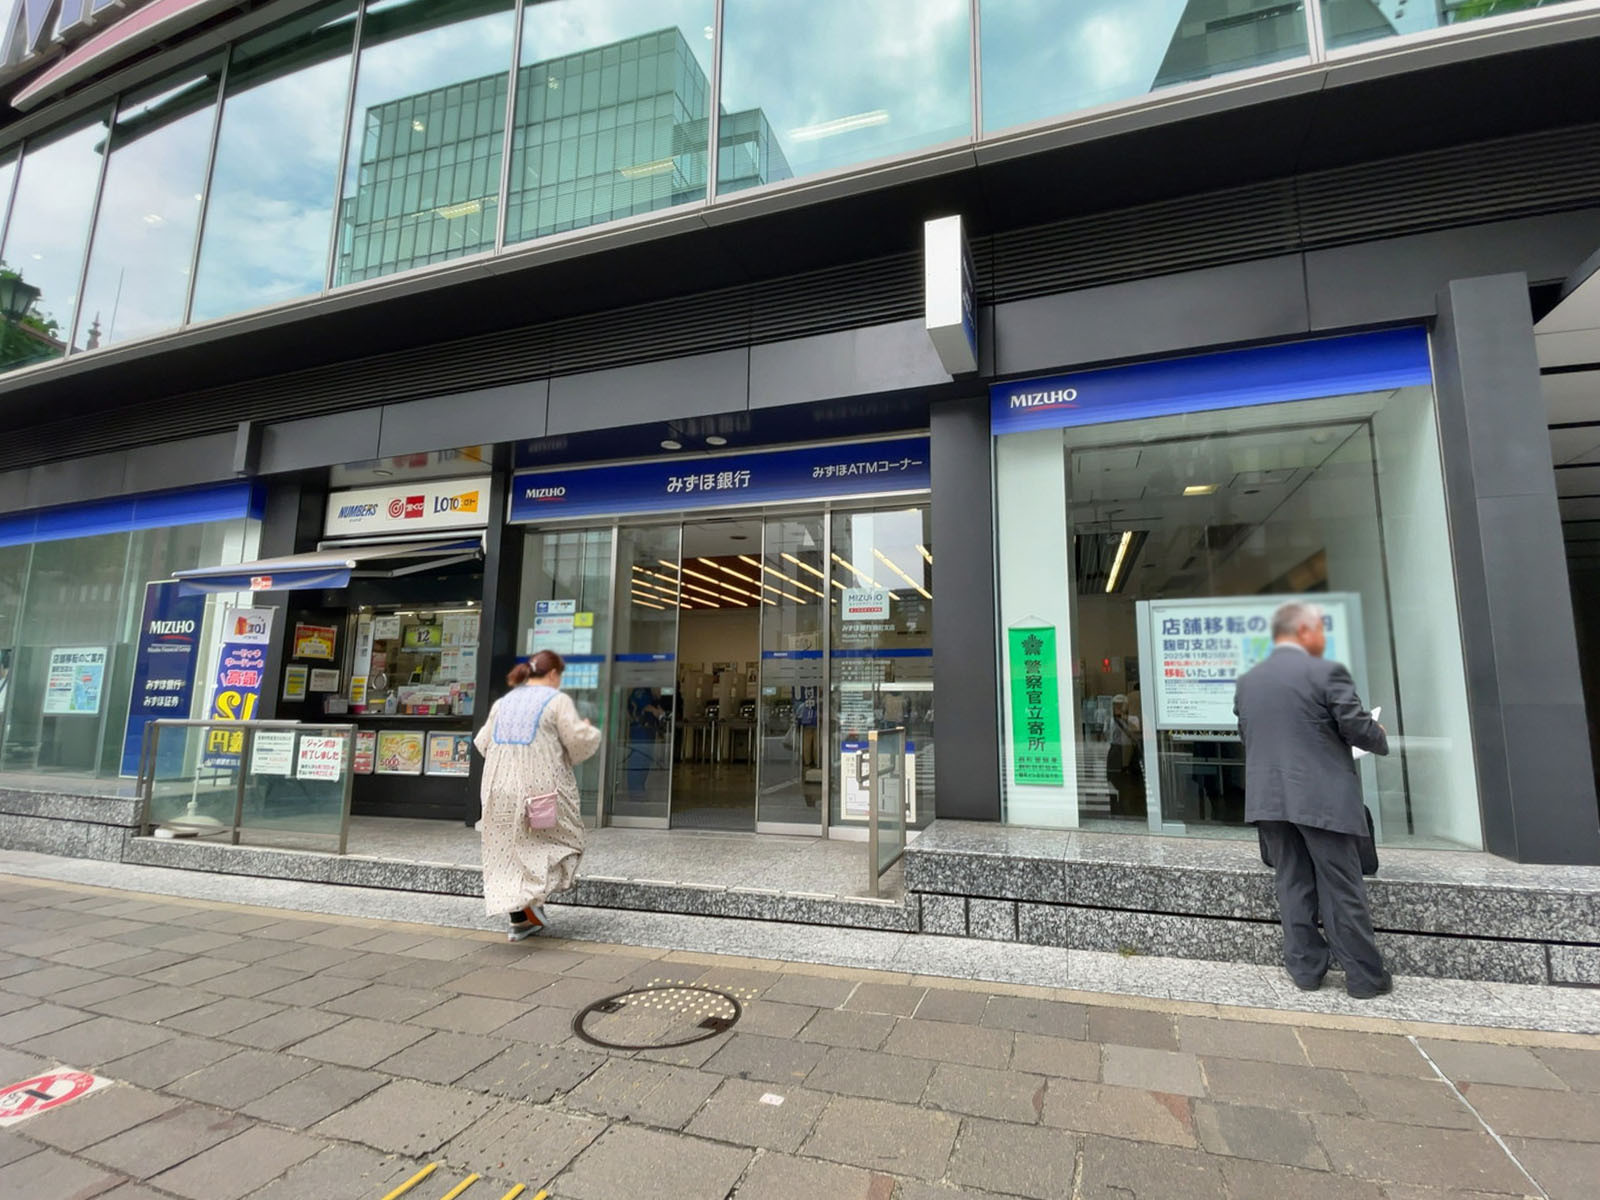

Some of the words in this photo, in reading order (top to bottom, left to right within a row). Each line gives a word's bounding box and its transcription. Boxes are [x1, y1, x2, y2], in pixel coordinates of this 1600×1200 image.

[1010, 388, 1077, 408] MIZUHO
[812, 458, 923, 478] みずほATMコーナー
[667, 470, 751, 493] みずほ銀行
[525, 486, 566, 499] MIZUHO
[338, 503, 378, 519] NUMBERS
[149, 620, 195, 635] MIZUHO
[145, 679, 181, 691] みずほ銀行
[143, 696, 179, 707] みずほ証券
[1024, 659, 1046, 752] 警察官立寄所
